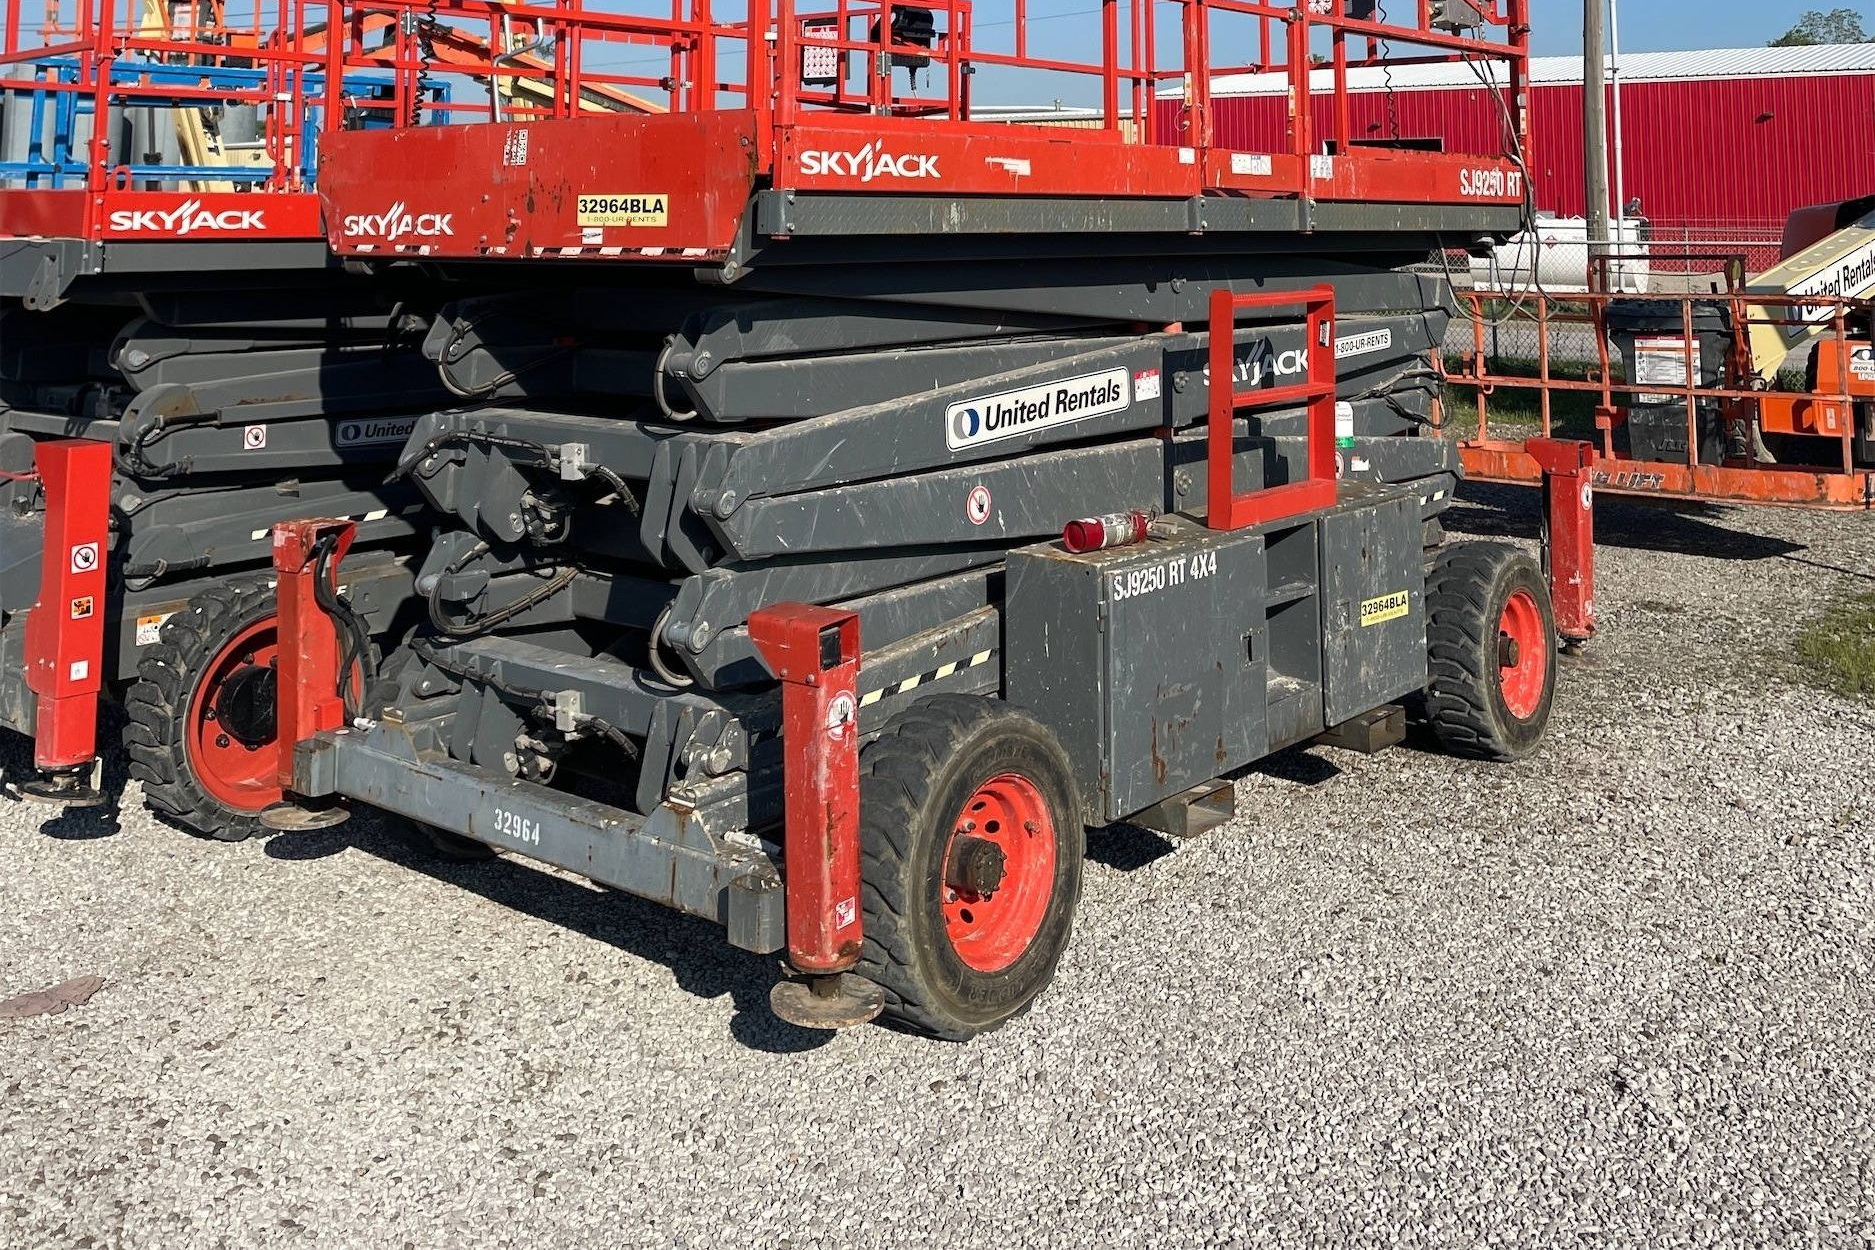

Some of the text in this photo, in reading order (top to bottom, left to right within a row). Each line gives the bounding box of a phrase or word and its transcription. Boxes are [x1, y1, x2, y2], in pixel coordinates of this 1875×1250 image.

[800, 137, 942, 183] SKYJACK
[1460, 166, 1521, 197] SJ9250 RT
[109, 199, 267, 235] SKYJACK
[343, 200, 455, 241] SKYJACK
[579, 198, 664, 214] 32964BLA
[1842, 249, 1875, 292] Rental
[1335, 333, 1389, 354] 1-800-UR-RENTS
[985, 393, 1050, 431] United
[1055, 379, 1121, 414] Rentals
[365, 420, 416, 438] United
[1113, 551, 1217, 601] SJ9250 RT 4X4
[1362, 594, 1407, 616] 32964BLA
[494, 808, 540, 845] 32964
